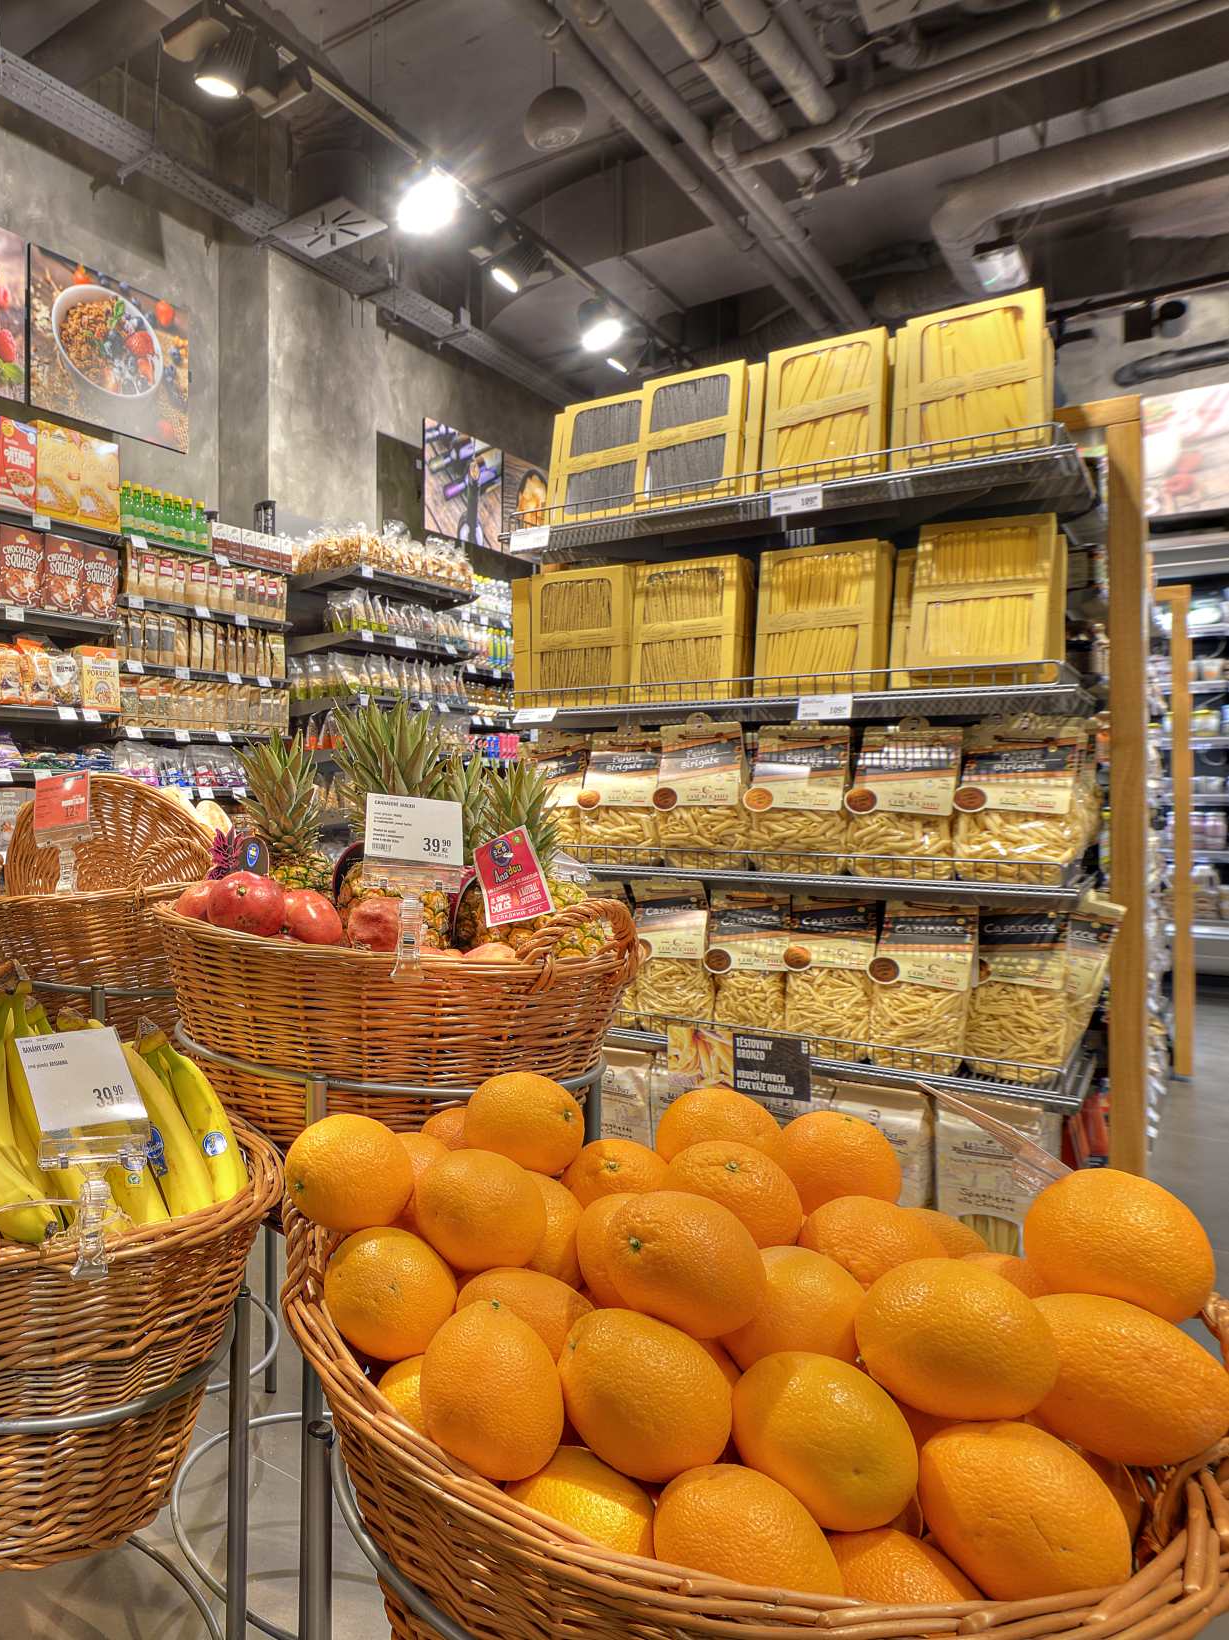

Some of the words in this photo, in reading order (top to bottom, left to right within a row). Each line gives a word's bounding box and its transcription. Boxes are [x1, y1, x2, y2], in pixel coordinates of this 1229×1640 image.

[2, 544, 43, 562] CHOCOLATEY
[5, 554, 38, 572] SQUARES
[423, 837, 440, 852] 39
[442, 839, 451, 847] 90
[93, 1087, 114, 1108] 39
[112, 1084, 124, 1096] 90
